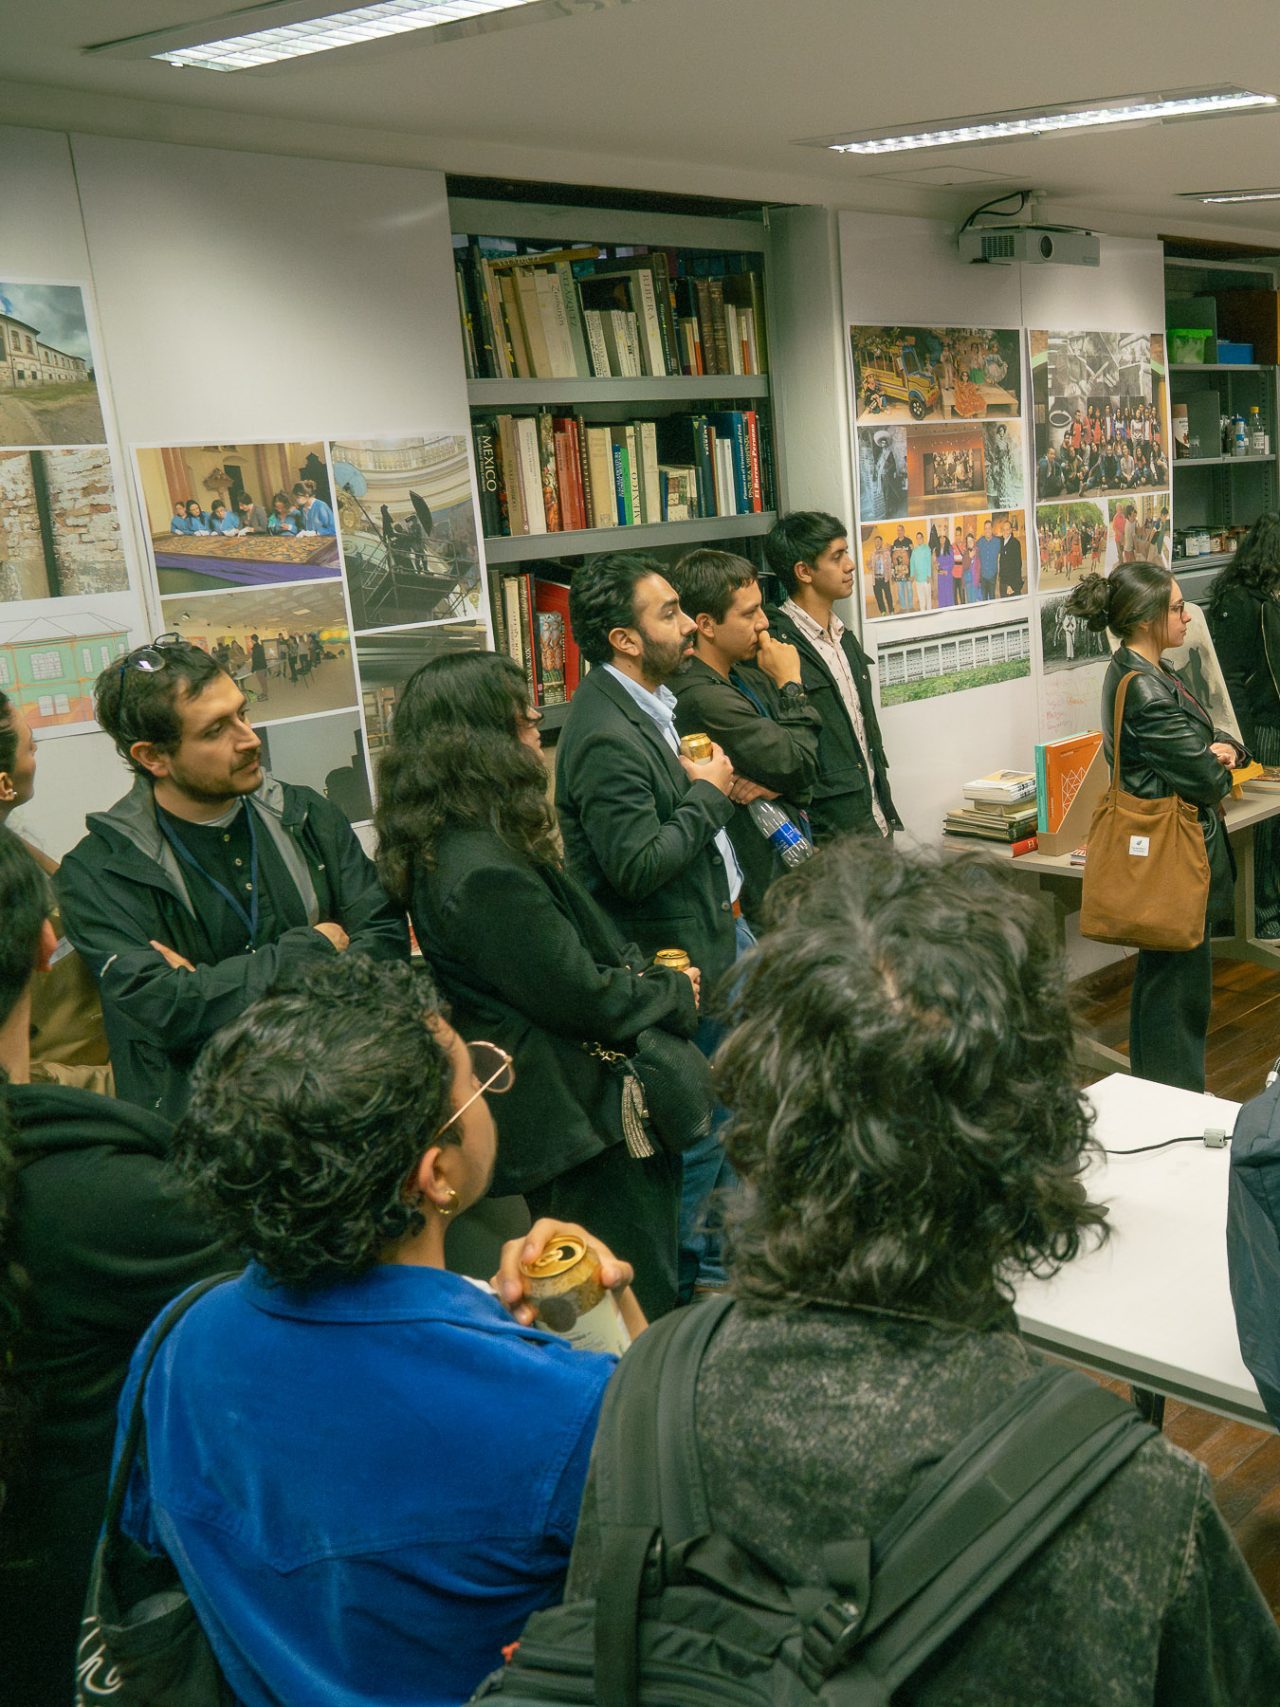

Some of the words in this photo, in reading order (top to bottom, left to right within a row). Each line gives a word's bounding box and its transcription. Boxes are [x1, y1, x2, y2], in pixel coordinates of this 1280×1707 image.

[642, 273, 655, 321] RIBERA
[481, 435, 497, 492] MEXICO
[630, 472, 641, 518] MEXICO
